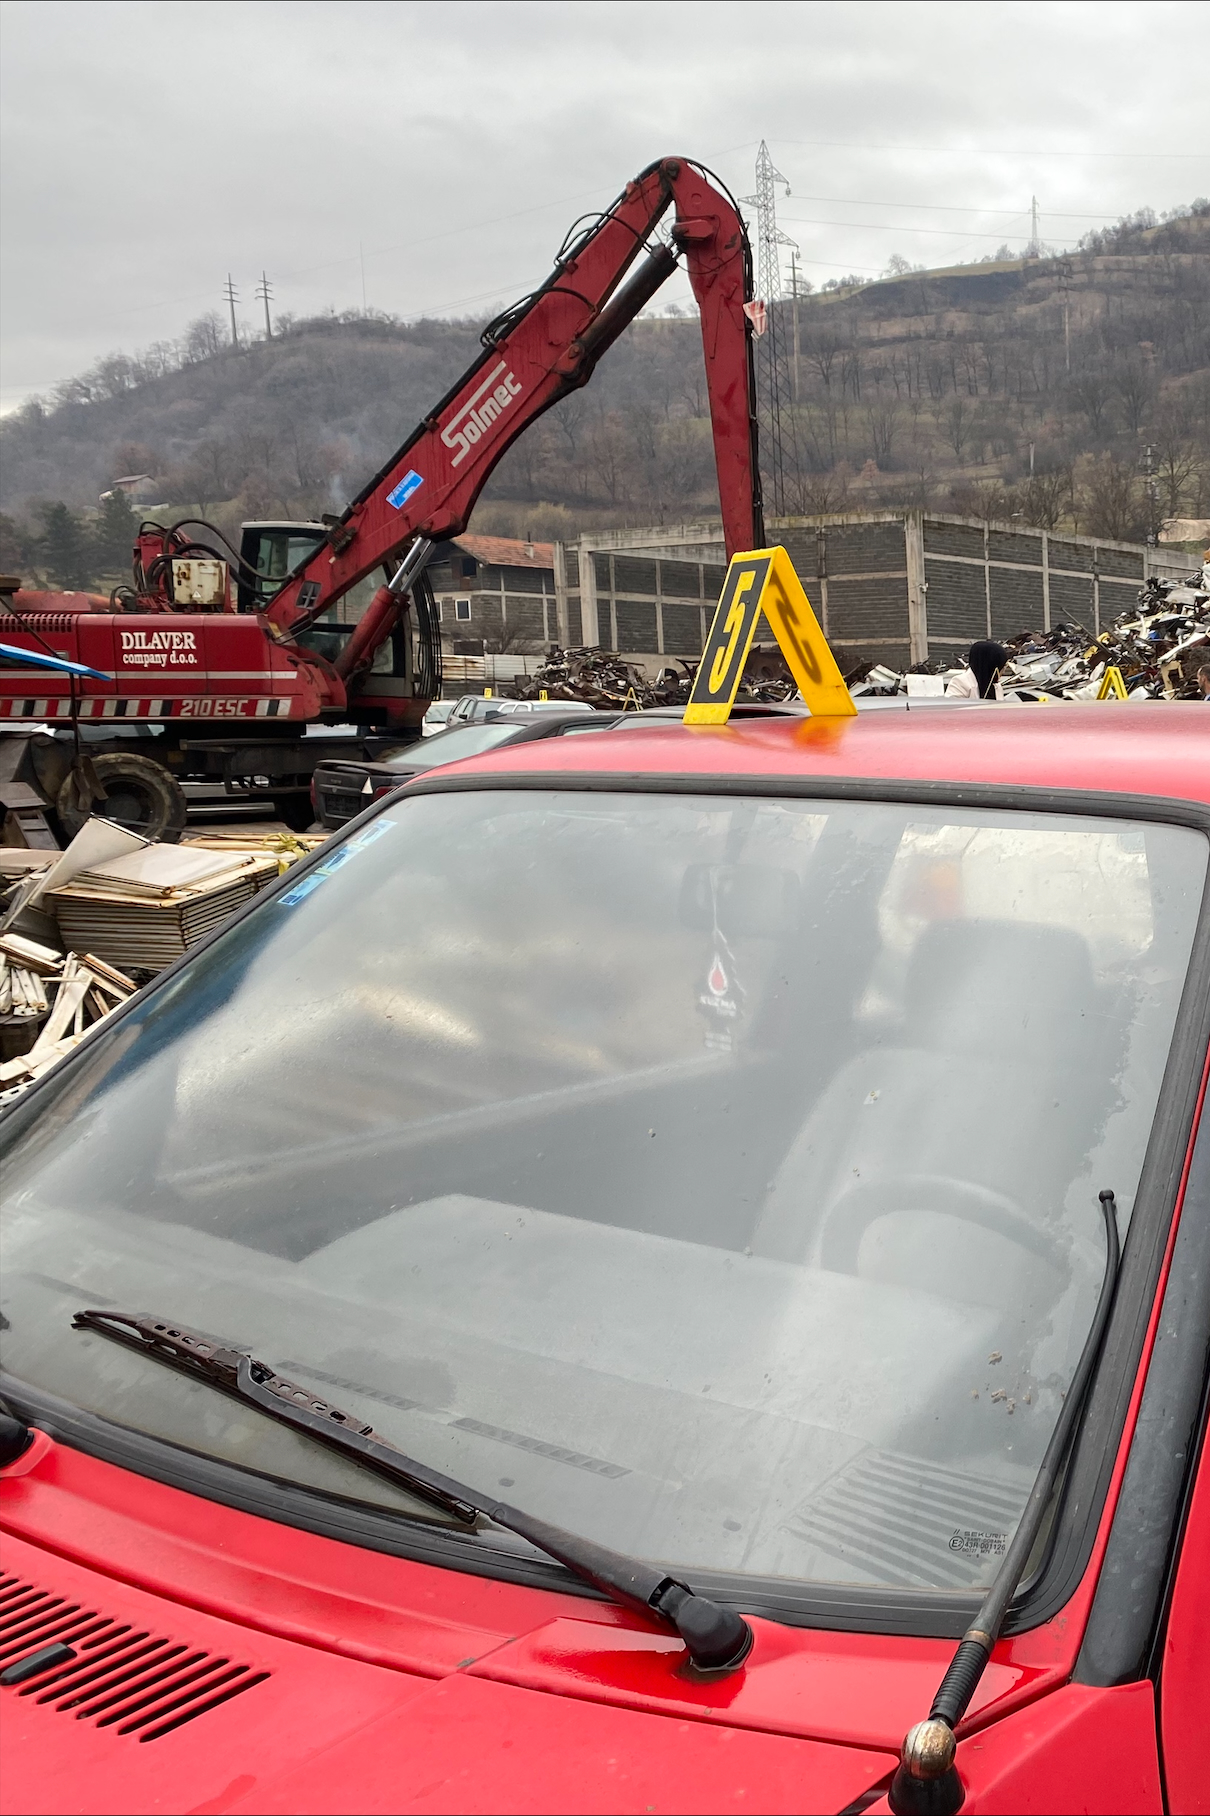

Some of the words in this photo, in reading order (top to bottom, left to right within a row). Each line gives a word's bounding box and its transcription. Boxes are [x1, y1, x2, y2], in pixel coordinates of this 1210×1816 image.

[441, 360, 522, 467] Solmec
[120, 631, 197, 650] DILAVER
[708, 570, 757, 695] 5
[122, 652, 168, 668] company
[169, 650, 198, 664] d.o.o.
[180, 699, 213, 717] 210
[213, 699, 249, 717] ESC
[964, 1531, 1008, 1540] SEKURIT
